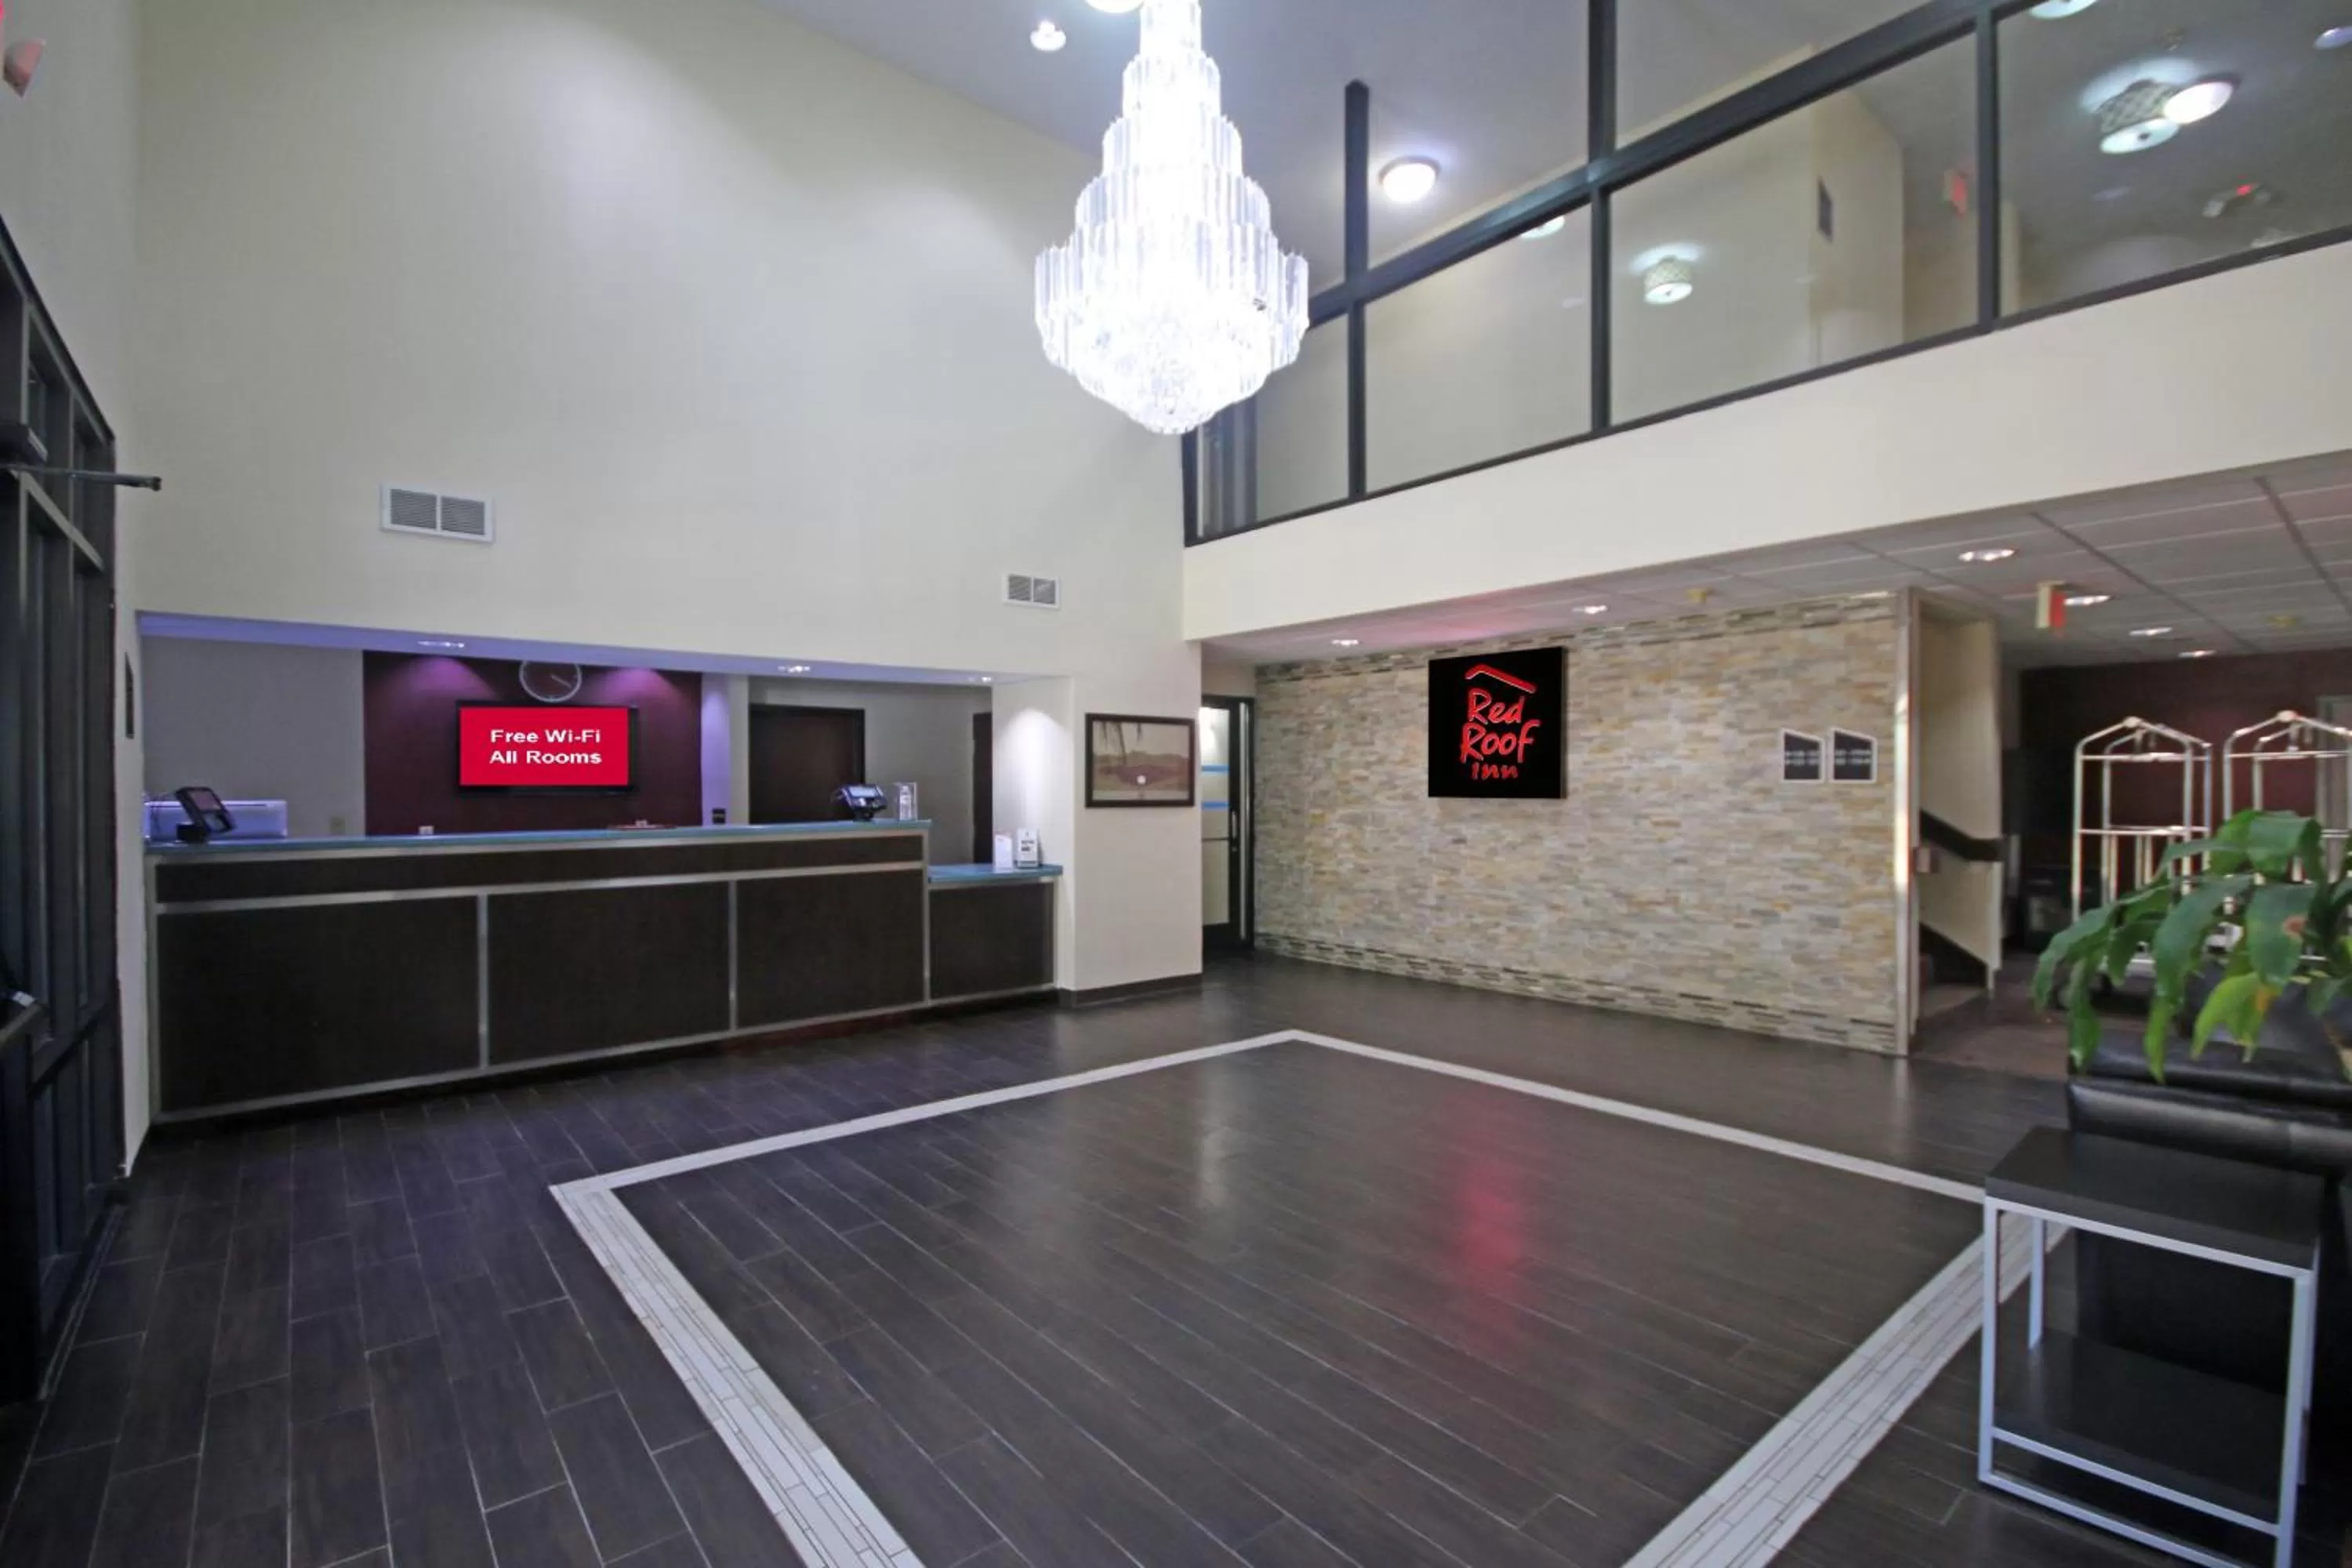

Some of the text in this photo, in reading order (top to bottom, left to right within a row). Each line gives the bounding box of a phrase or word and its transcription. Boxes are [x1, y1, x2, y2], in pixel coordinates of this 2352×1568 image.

[1467, 688, 1526, 724] Red
[490, 729, 602, 743] Free Wi-Fi
[1460, 719, 1541, 764] Roof
[489, 750, 603, 764] All Rooms
